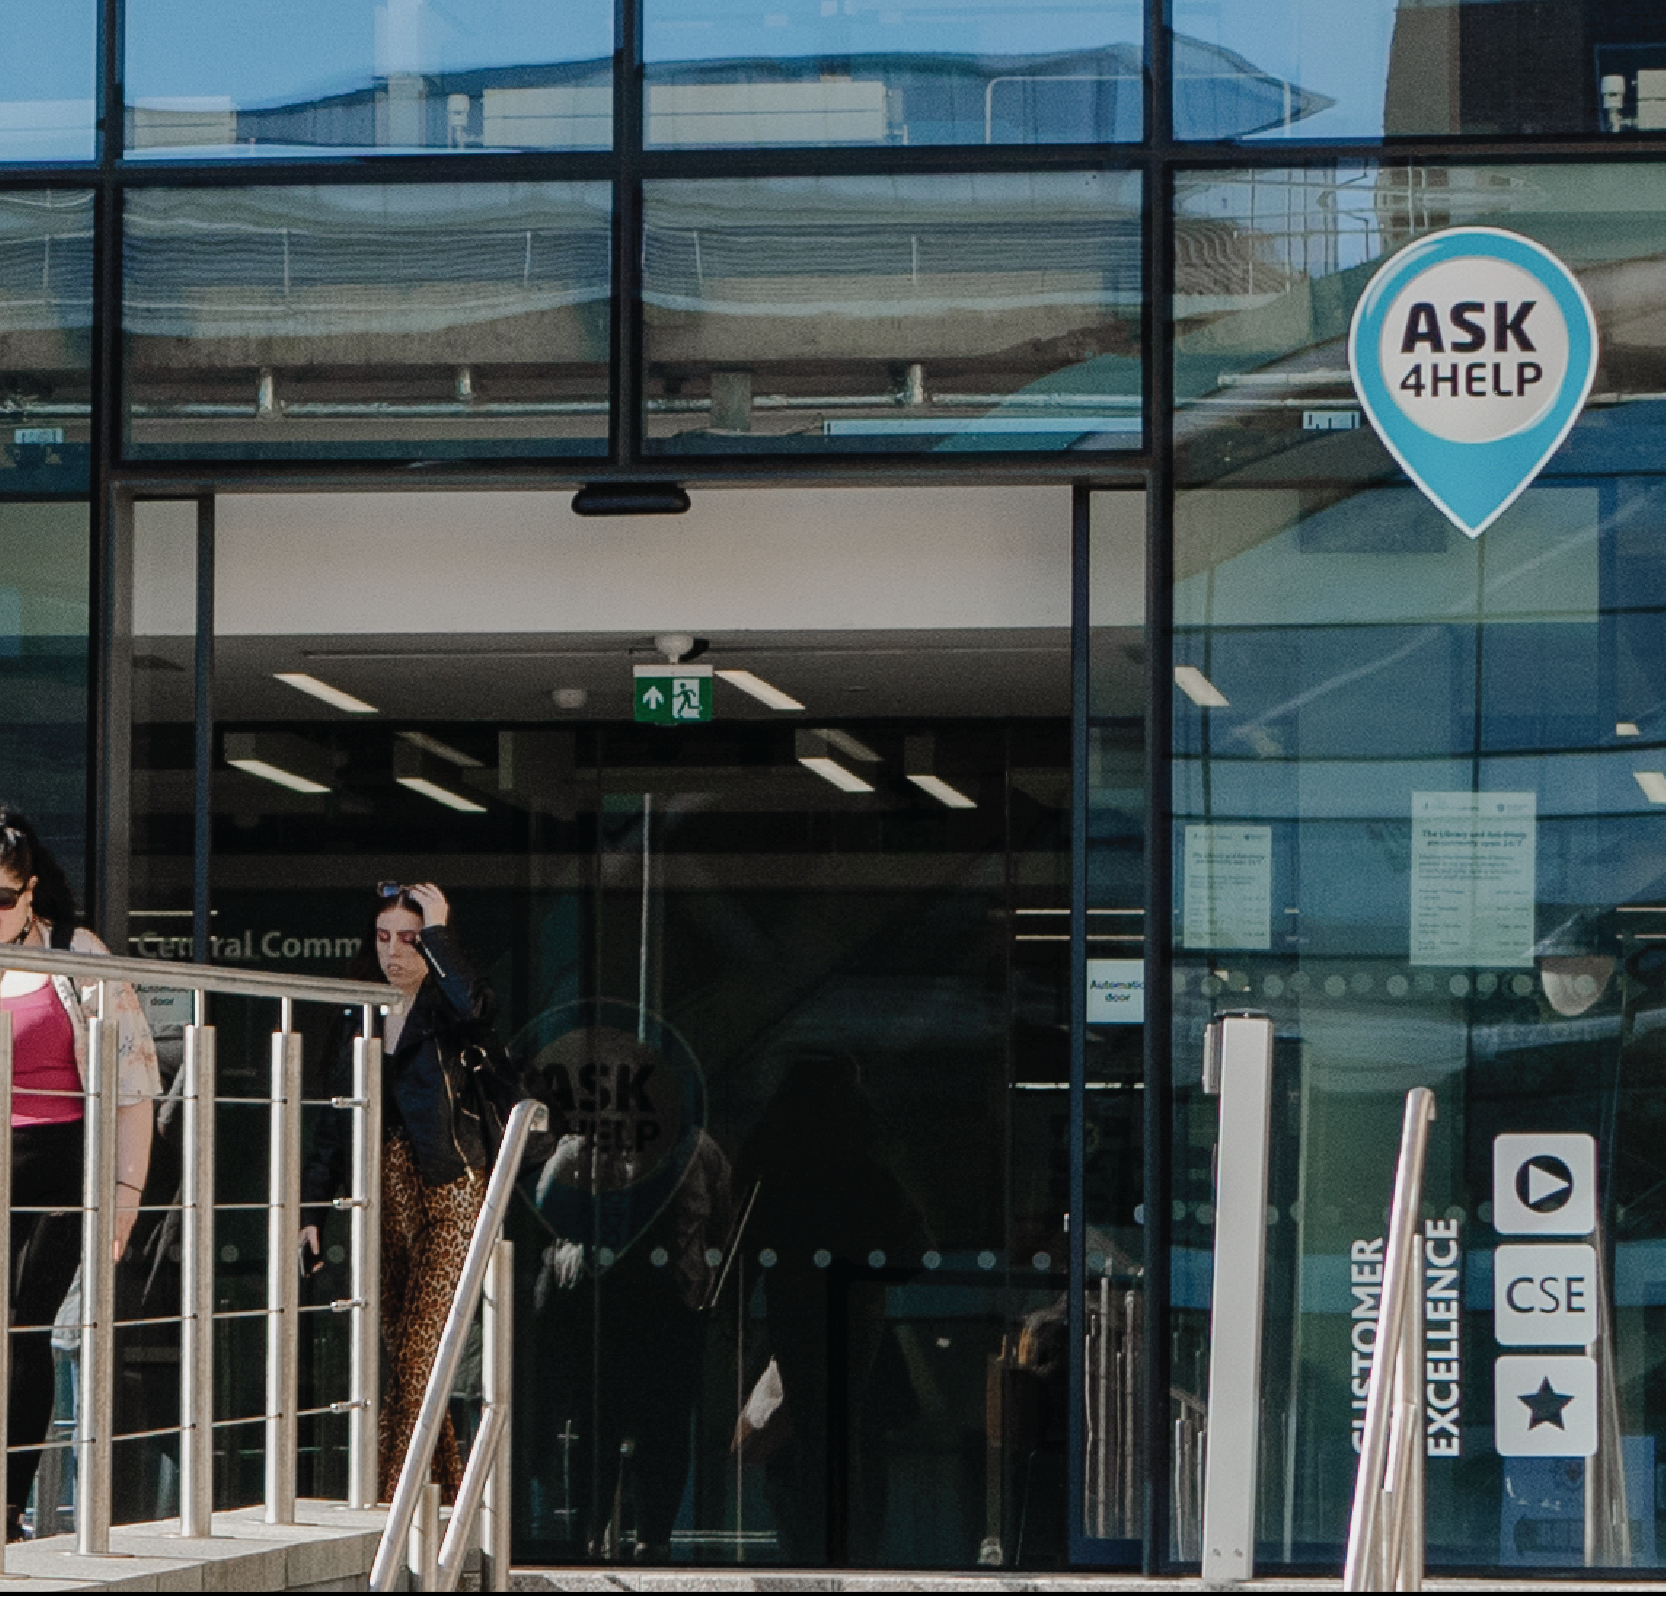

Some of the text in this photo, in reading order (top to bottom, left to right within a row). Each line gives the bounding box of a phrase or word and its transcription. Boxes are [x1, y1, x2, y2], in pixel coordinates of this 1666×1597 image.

[1400, 300, 1537, 354] ASK
[1399, 361, 1544, 397] 4HELP
[137, 929, 362, 958] Cenral Comm
[1506, 1276, 1586, 1314] CSE
[1425, 1218, 1461, 1457] EXCELLENCE
